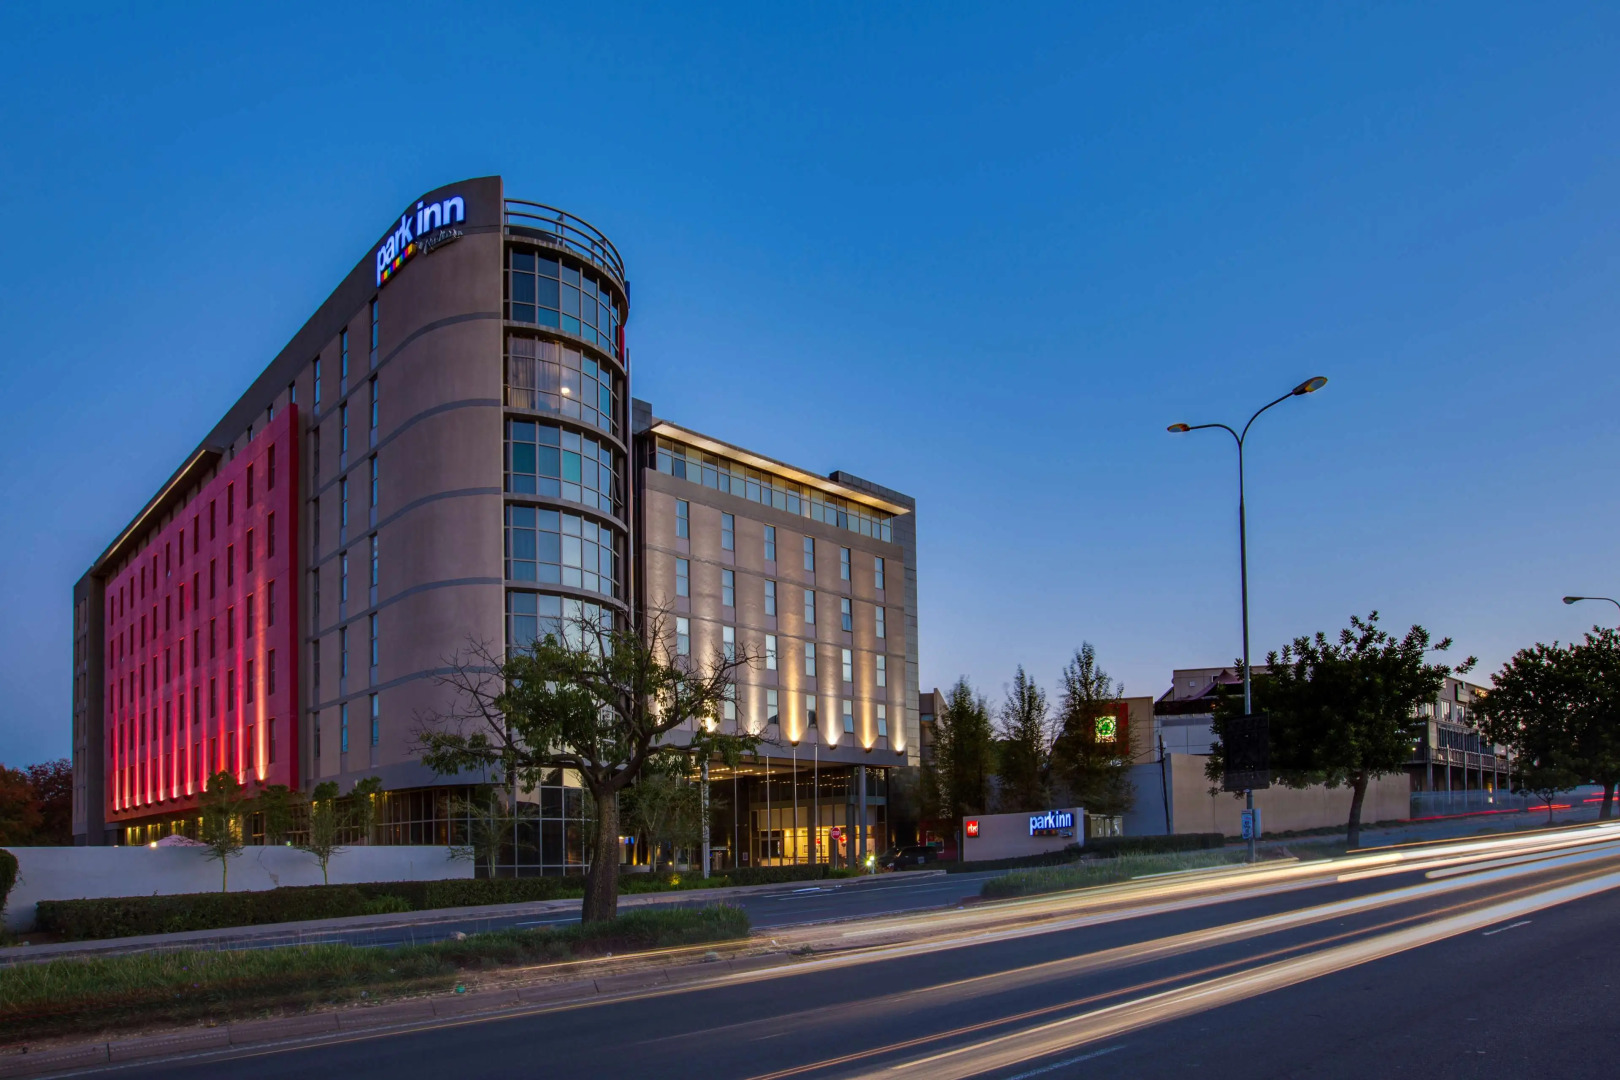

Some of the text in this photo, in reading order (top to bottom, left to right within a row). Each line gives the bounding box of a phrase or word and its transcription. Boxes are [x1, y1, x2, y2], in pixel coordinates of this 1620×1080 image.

[376, 214, 413, 288] park
[416, 196, 465, 236] inn
[1029, 811, 1055, 836] park
[1055, 810, 1072, 828] inn
